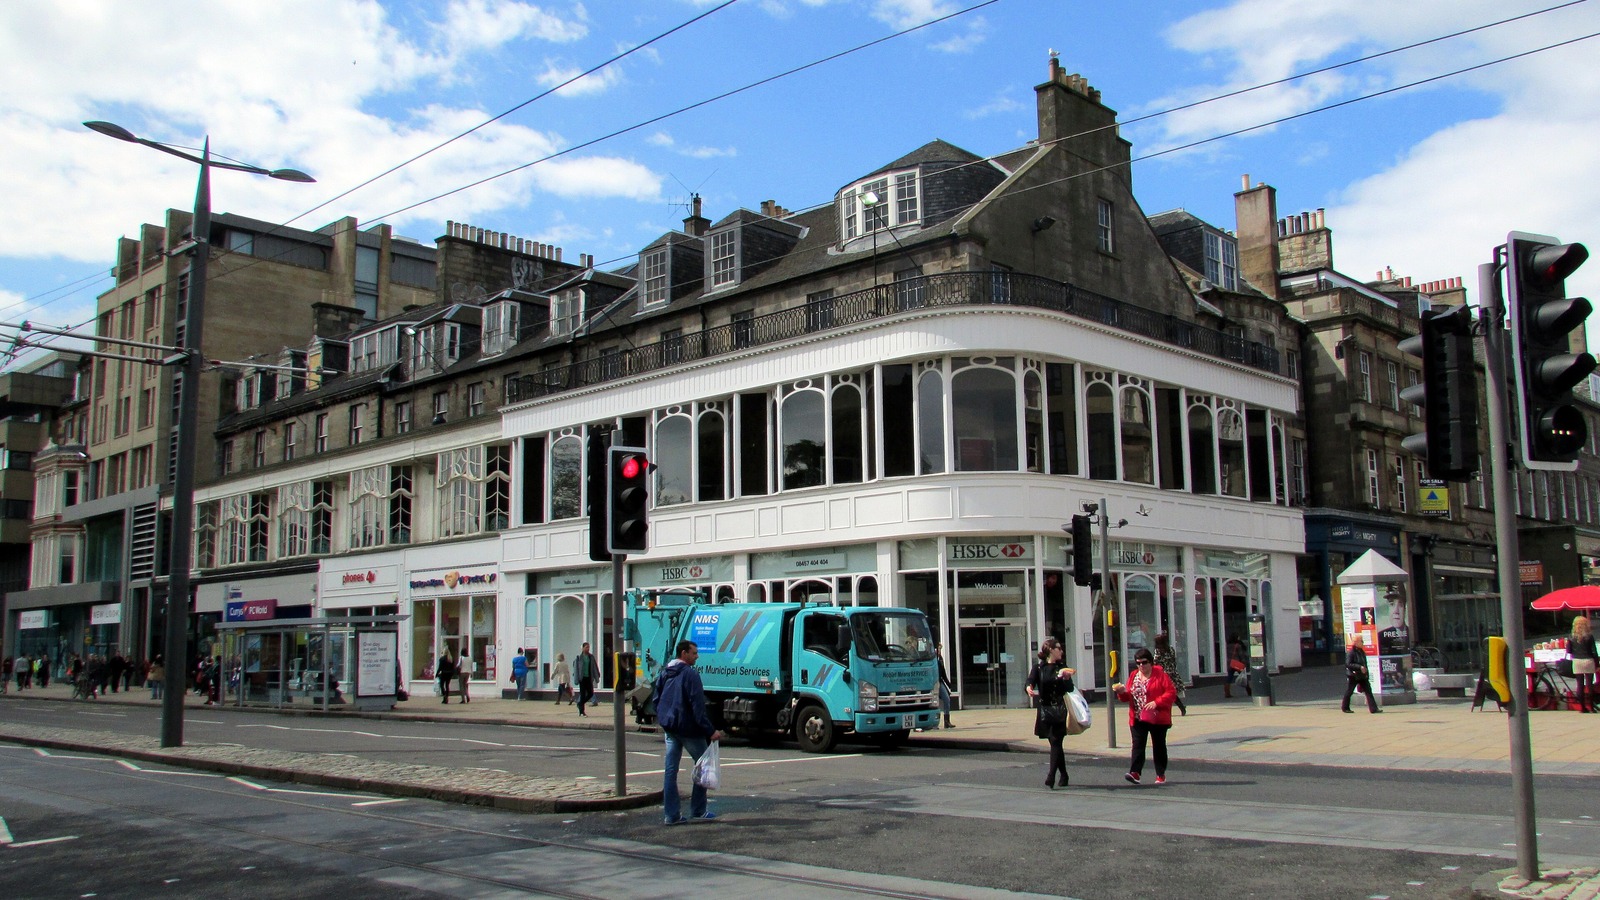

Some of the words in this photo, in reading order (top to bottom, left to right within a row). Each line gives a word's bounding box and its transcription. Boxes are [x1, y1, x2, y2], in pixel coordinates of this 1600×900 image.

[1362, 532, 1377, 541] MIGHTY
[952, 544, 1000, 559] HSBC
[1118, 551, 1143, 565] HSBC
[342, 572, 365, 585] phones
[661, 566, 688, 581] HSBC
[974, 582, 1008, 590] Welcome
[229, 607, 244, 618] Currys
[248, 606, 256, 615] PC
[256, 605, 268, 614] World
[694, 614, 719, 624] NMS
[705, 665, 737, 677] Municipal
[739, 666, 770, 677] Services
